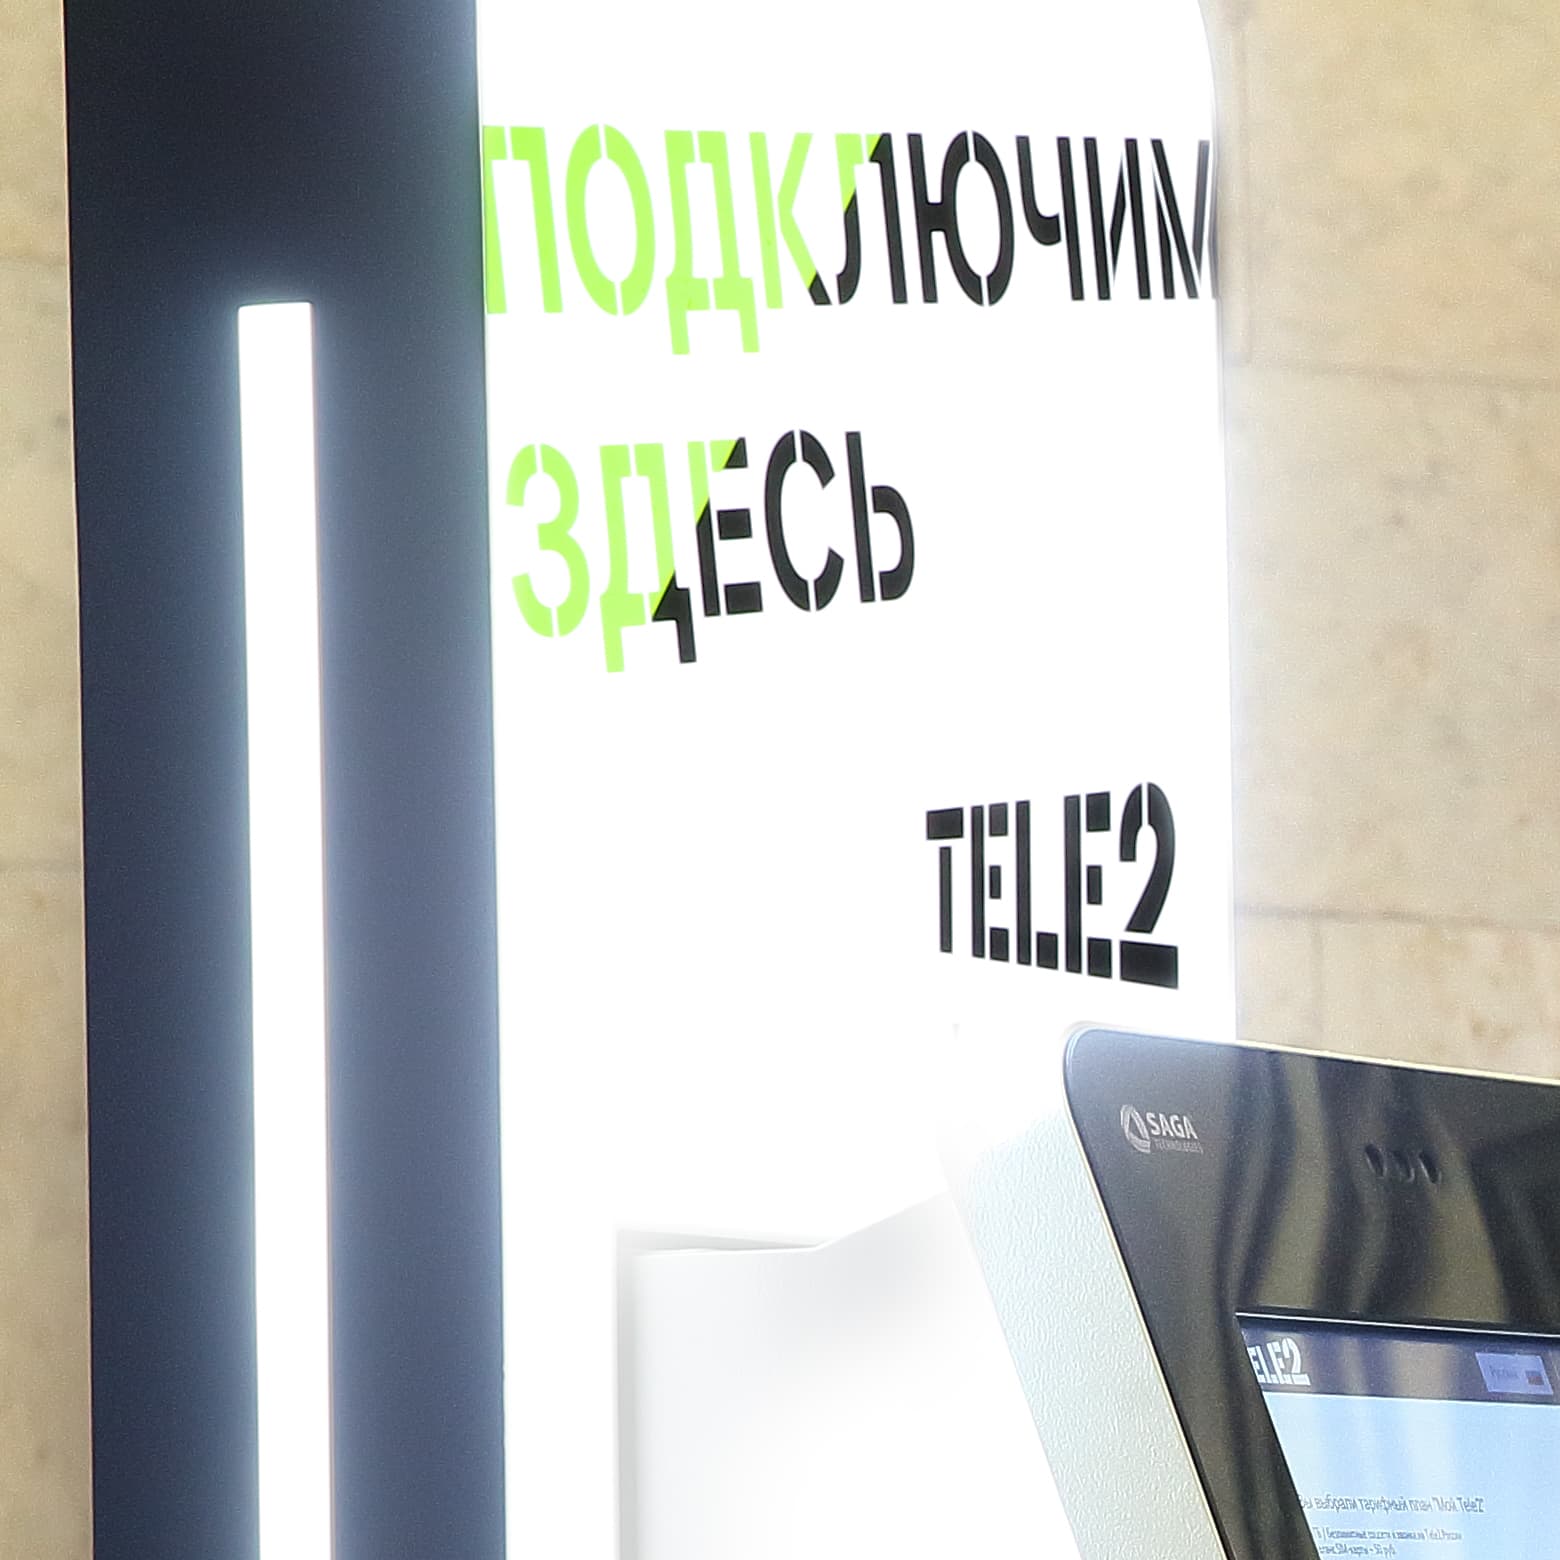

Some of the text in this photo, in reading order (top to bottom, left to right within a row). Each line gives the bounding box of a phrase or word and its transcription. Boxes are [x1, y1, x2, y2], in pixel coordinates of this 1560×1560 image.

[482, 124, 1220, 355] ПОДКЛЮЧИМ
[506, 429, 915, 673] ЗДЕСЬ
[925, 781, 1179, 989] TELE2
[1145, 1112, 1199, 1140] SAGA
